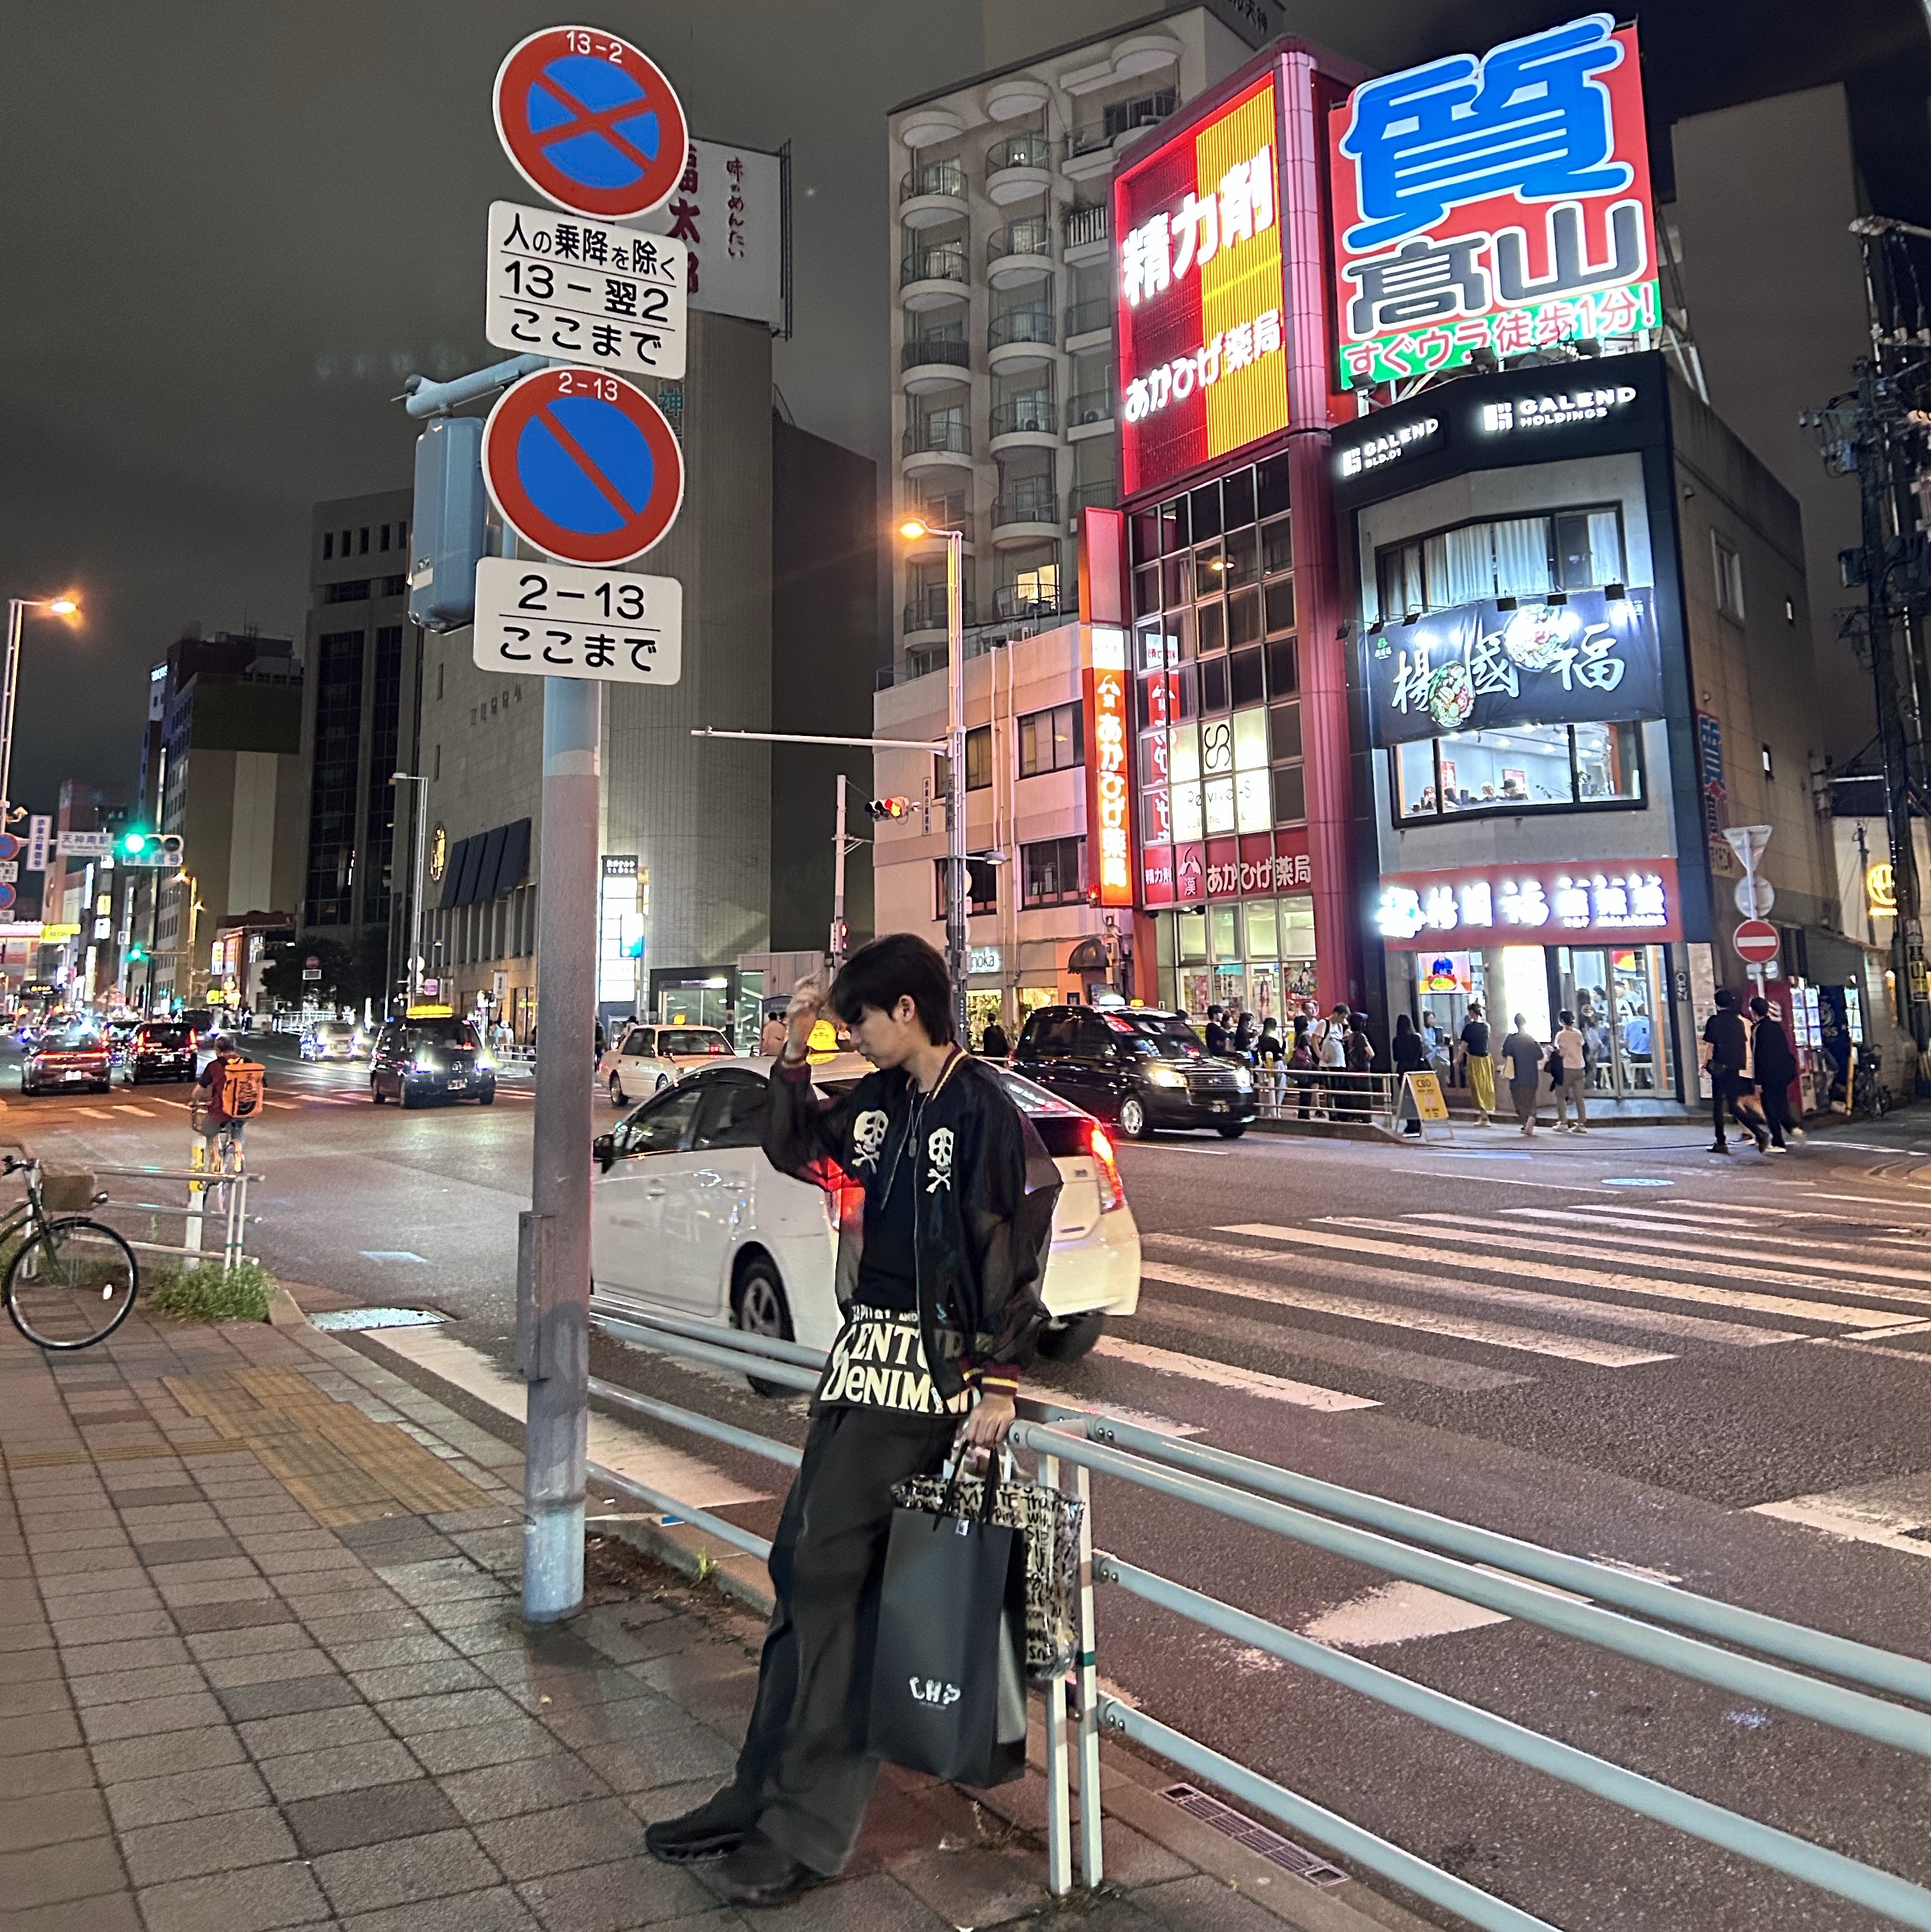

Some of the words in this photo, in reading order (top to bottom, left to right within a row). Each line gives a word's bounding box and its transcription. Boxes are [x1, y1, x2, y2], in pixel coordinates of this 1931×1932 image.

[567, 30, 623, 65] 13-2
[1340, 12, 1635, 254] 質
[503, 212, 676, 281] 人の乗降を除く
[1122, 144, 1276, 308] 精力剤
[510, 307, 662, 365] ここまで
[558, 372, 618, 401] 2-13
[1125, 308, 1283, 422] あかひげ薬局
[1520, 387, 1637, 415] GALEND
[1520, 407, 1608, 427] HOLDINGS
[1364, 417, 1439, 458] GALEND
[518, 574, 645, 620] 2-13
[500, 626, 657, 672] ここまで
[1207, 854, 1311, 894] あかひげ薬局
[1416, 1078, 1431, 1088] CBD
